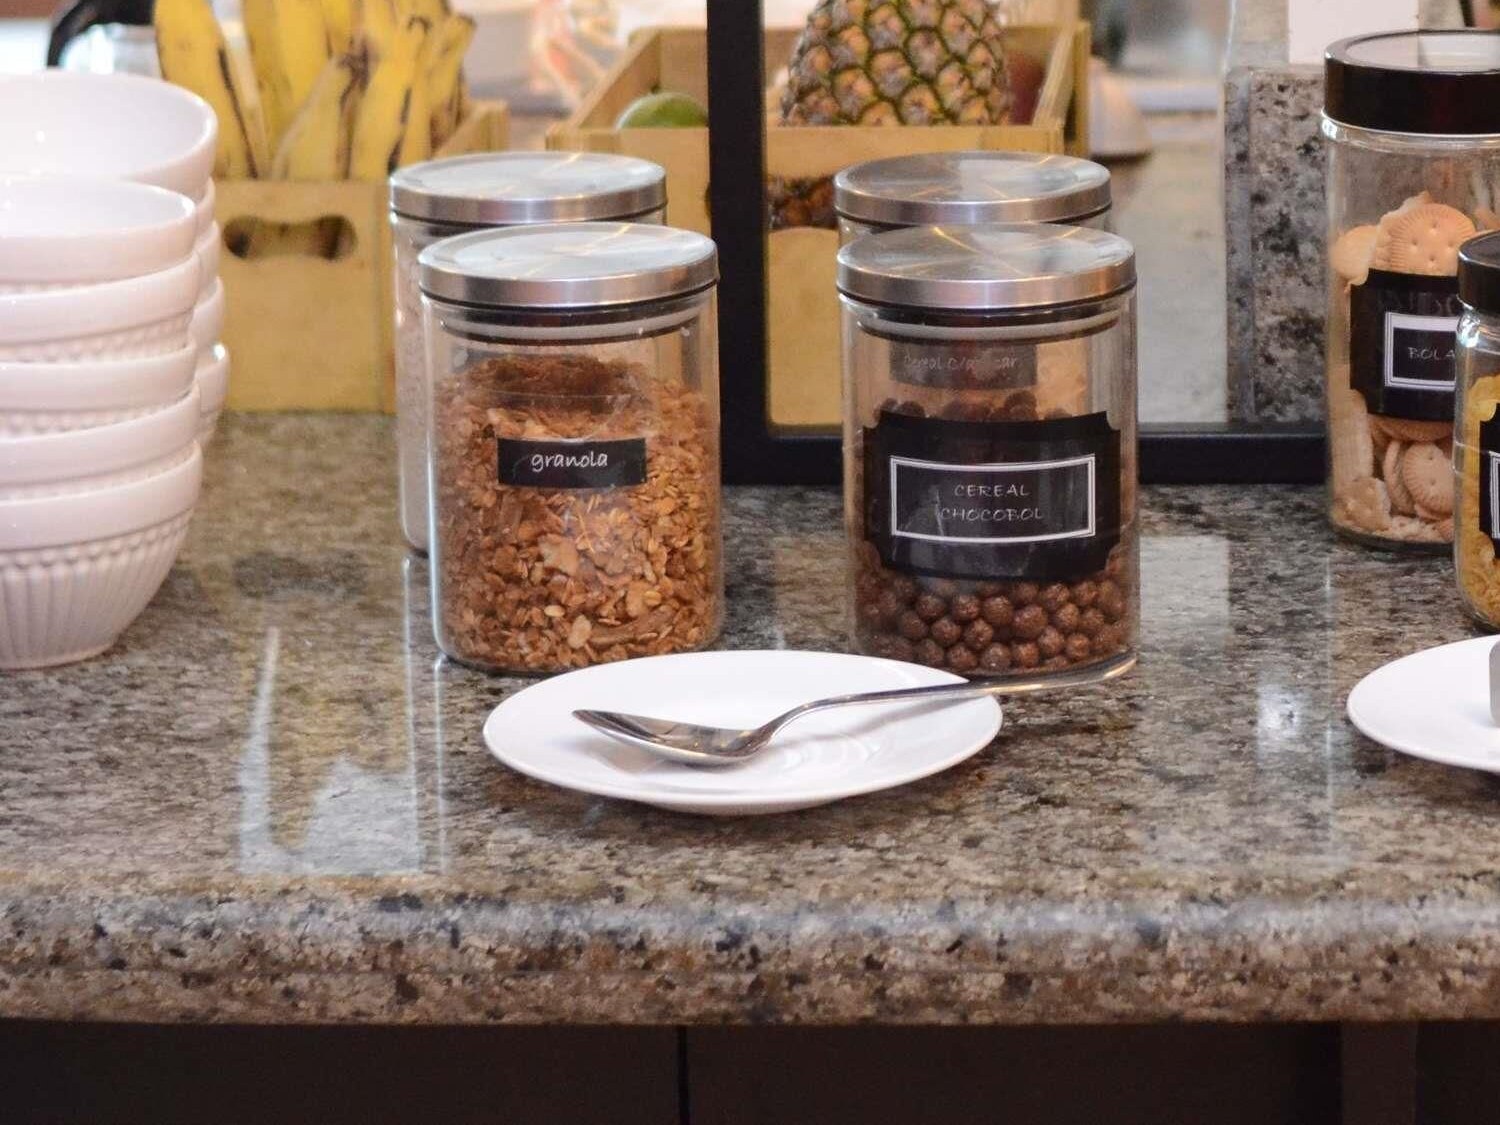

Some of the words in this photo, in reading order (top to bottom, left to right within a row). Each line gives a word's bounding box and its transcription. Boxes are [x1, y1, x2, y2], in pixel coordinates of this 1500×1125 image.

[1407, 346, 1456, 361] BOLA
[530, 451, 608, 473] granola
[954, 483, 1031, 499] CEREAL
[939, 507, 1045, 523] CHOCOBOL
